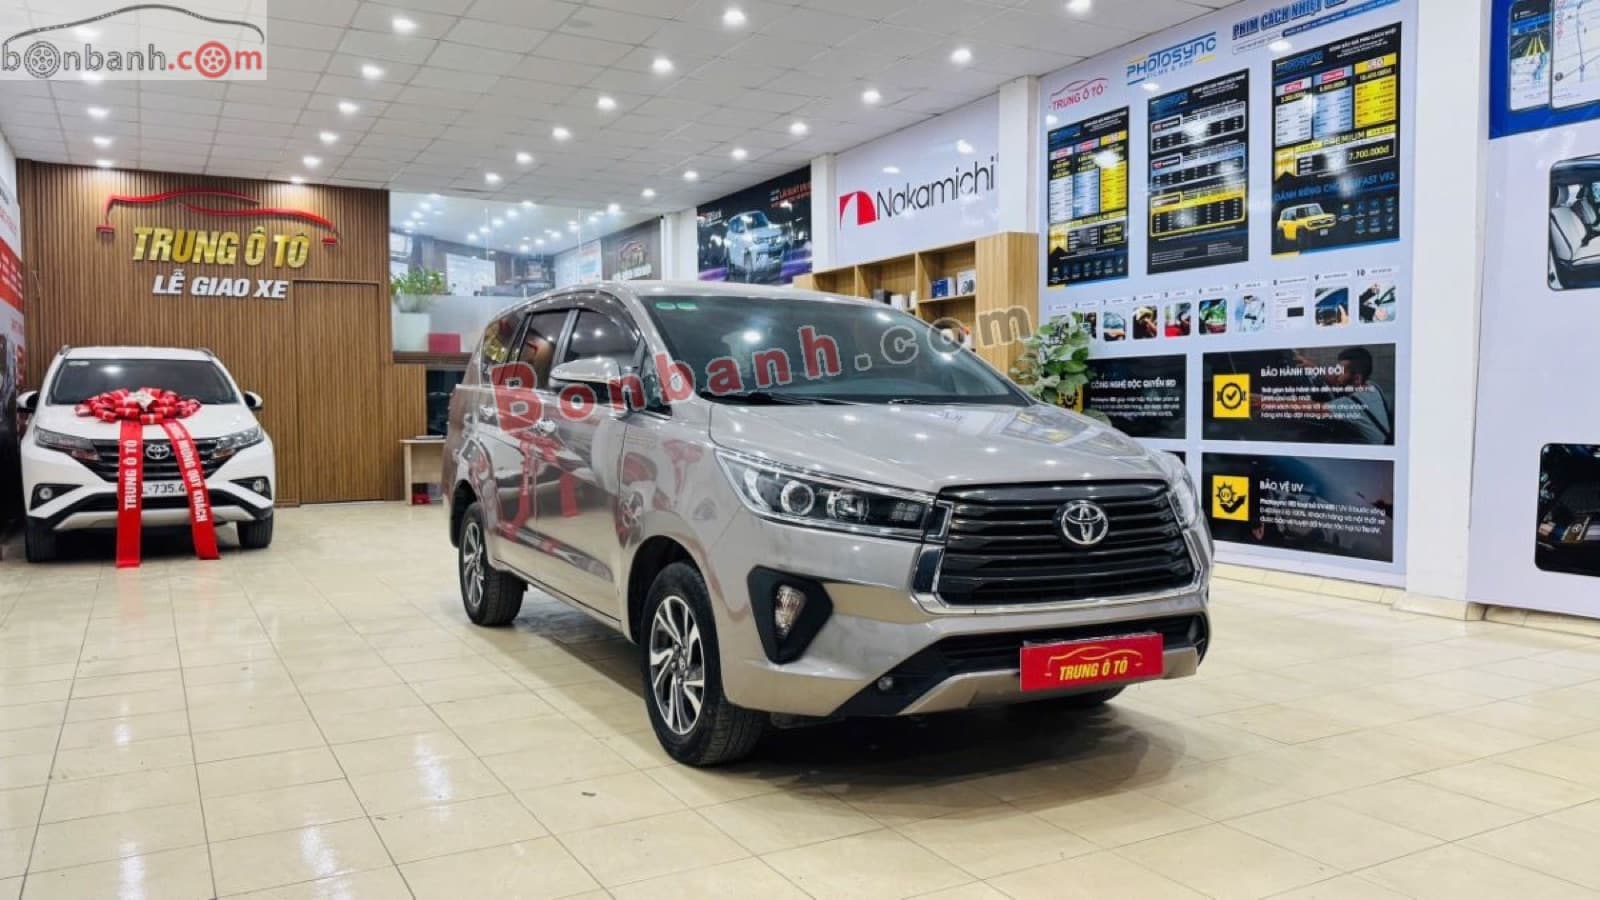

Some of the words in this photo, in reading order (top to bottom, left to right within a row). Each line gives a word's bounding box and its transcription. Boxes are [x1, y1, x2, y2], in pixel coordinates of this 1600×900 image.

[1052, 92, 1081, 111] TRUNG
[1082, 87, 1090, 100] Ô
[1092, 83, 1104, 96] TÔ
[876, 155, 995, 221] Nakamichi
[132, 226, 237, 266] TRUNG
[245, 226, 265, 267] Ô
[272, 231, 311, 269] TÔ
[153, 268, 185, 296] LỄ
[190, 275, 250, 299] GIAO
[253, 279, 289, 300] XE
[1261, 365, 1278, 377] BẢO
[1280, 365, 1303, 377] HÀNH
[1304, 366, 1326, 378] TRỌN
[123, 439, 138, 456] TÔ
[123, 468, 138, 511] TRUNG
[1260, 478, 1277, 490] BẢO
[1059, 663, 1100, 681] TRUNG
[1102, 660, 1111, 677] Ô
[1113, 656, 1129, 674] TÔ
